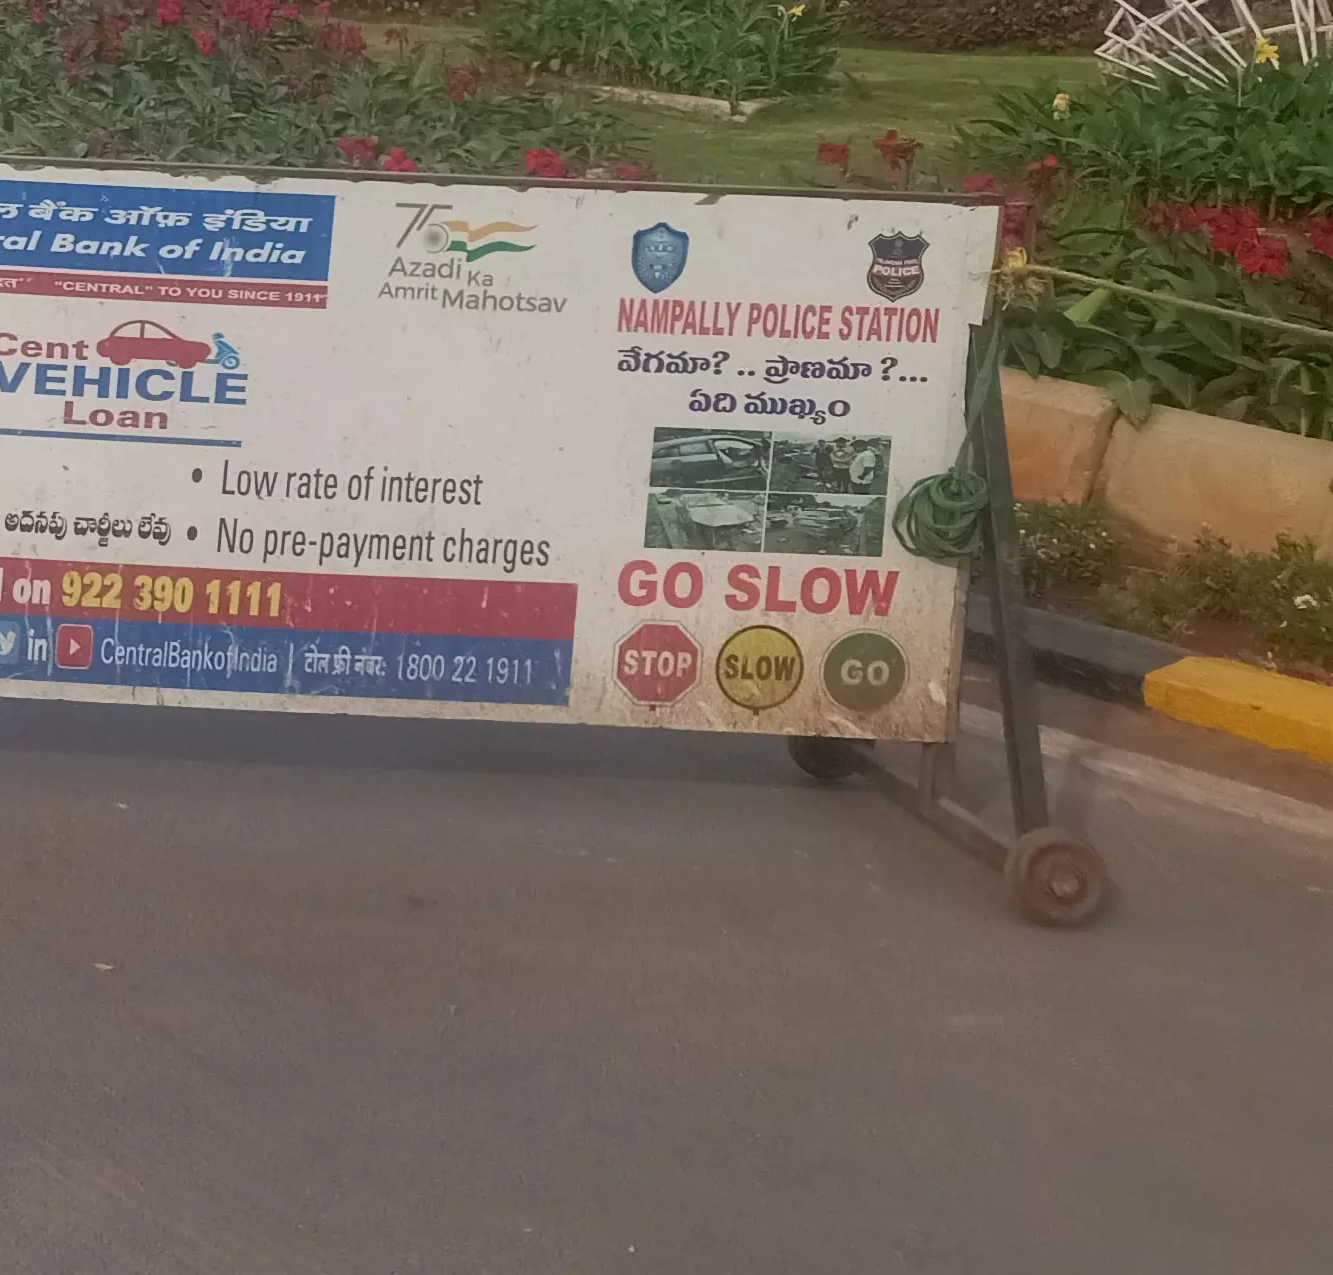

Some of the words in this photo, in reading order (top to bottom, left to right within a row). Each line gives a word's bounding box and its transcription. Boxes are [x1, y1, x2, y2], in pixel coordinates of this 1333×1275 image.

[28, 199, 99, 223] बैंक
[202, 209, 314, 234] इंडिया
[51, 233, 148, 258] Bank
[159, 237, 201, 260] of
[209, 241, 307, 265] India
[388, 256, 463, 280] Azadi
[467, 269, 494, 287] Ka
[872, 264, 921, 277] POLICE
[157, 286, 181, 297] TO
[185, 286, 223, 299] YOU
[228, 288, 280, 301] SINCE
[377, 281, 438, 301] Amrit
[441, 288, 568, 314] Mahotsav
[617, 297, 742, 337] NAMPALLY
[747, 302, 833, 340] POLICE
[839, 304, 941, 343] STATION
[763, 354, 873, 384] ప్రాణమా
[63, 400, 168, 430] Loan
[688, 387, 738, 414] ఏది
[743, 390, 851, 426] ముఖ్యం
[221, 459, 278, 498] Low
[285, 467, 337, 500] rate
[347, 466, 374, 501] of
[380, 465, 484, 506] interest
[4, 510, 68, 541] అదనపు
[137, 512, 172, 546] లేవు
[216, 516, 254, 554] No
[262, 528, 435, 567] pre-payment
[442, 528, 551, 573] charges
[13, 576, 51, 606] on
[61, 570, 123, 609] 922
[133, 575, 194, 614] 390
[205, 579, 282, 617] 1111
[617, 559, 704, 609] GO
[724, 563, 900, 617] SLOW
[100, 639, 278, 674] CentralBankofIndia
[305, 644, 330, 674] टोल
[396, 653, 445, 681] 1800
[451, 655, 477, 683] 22
[486, 657, 532, 684] 1911
[624, 649, 692, 678] STOP
[724, 654, 796, 682] SLOW
[841, 659, 890, 686] GO
